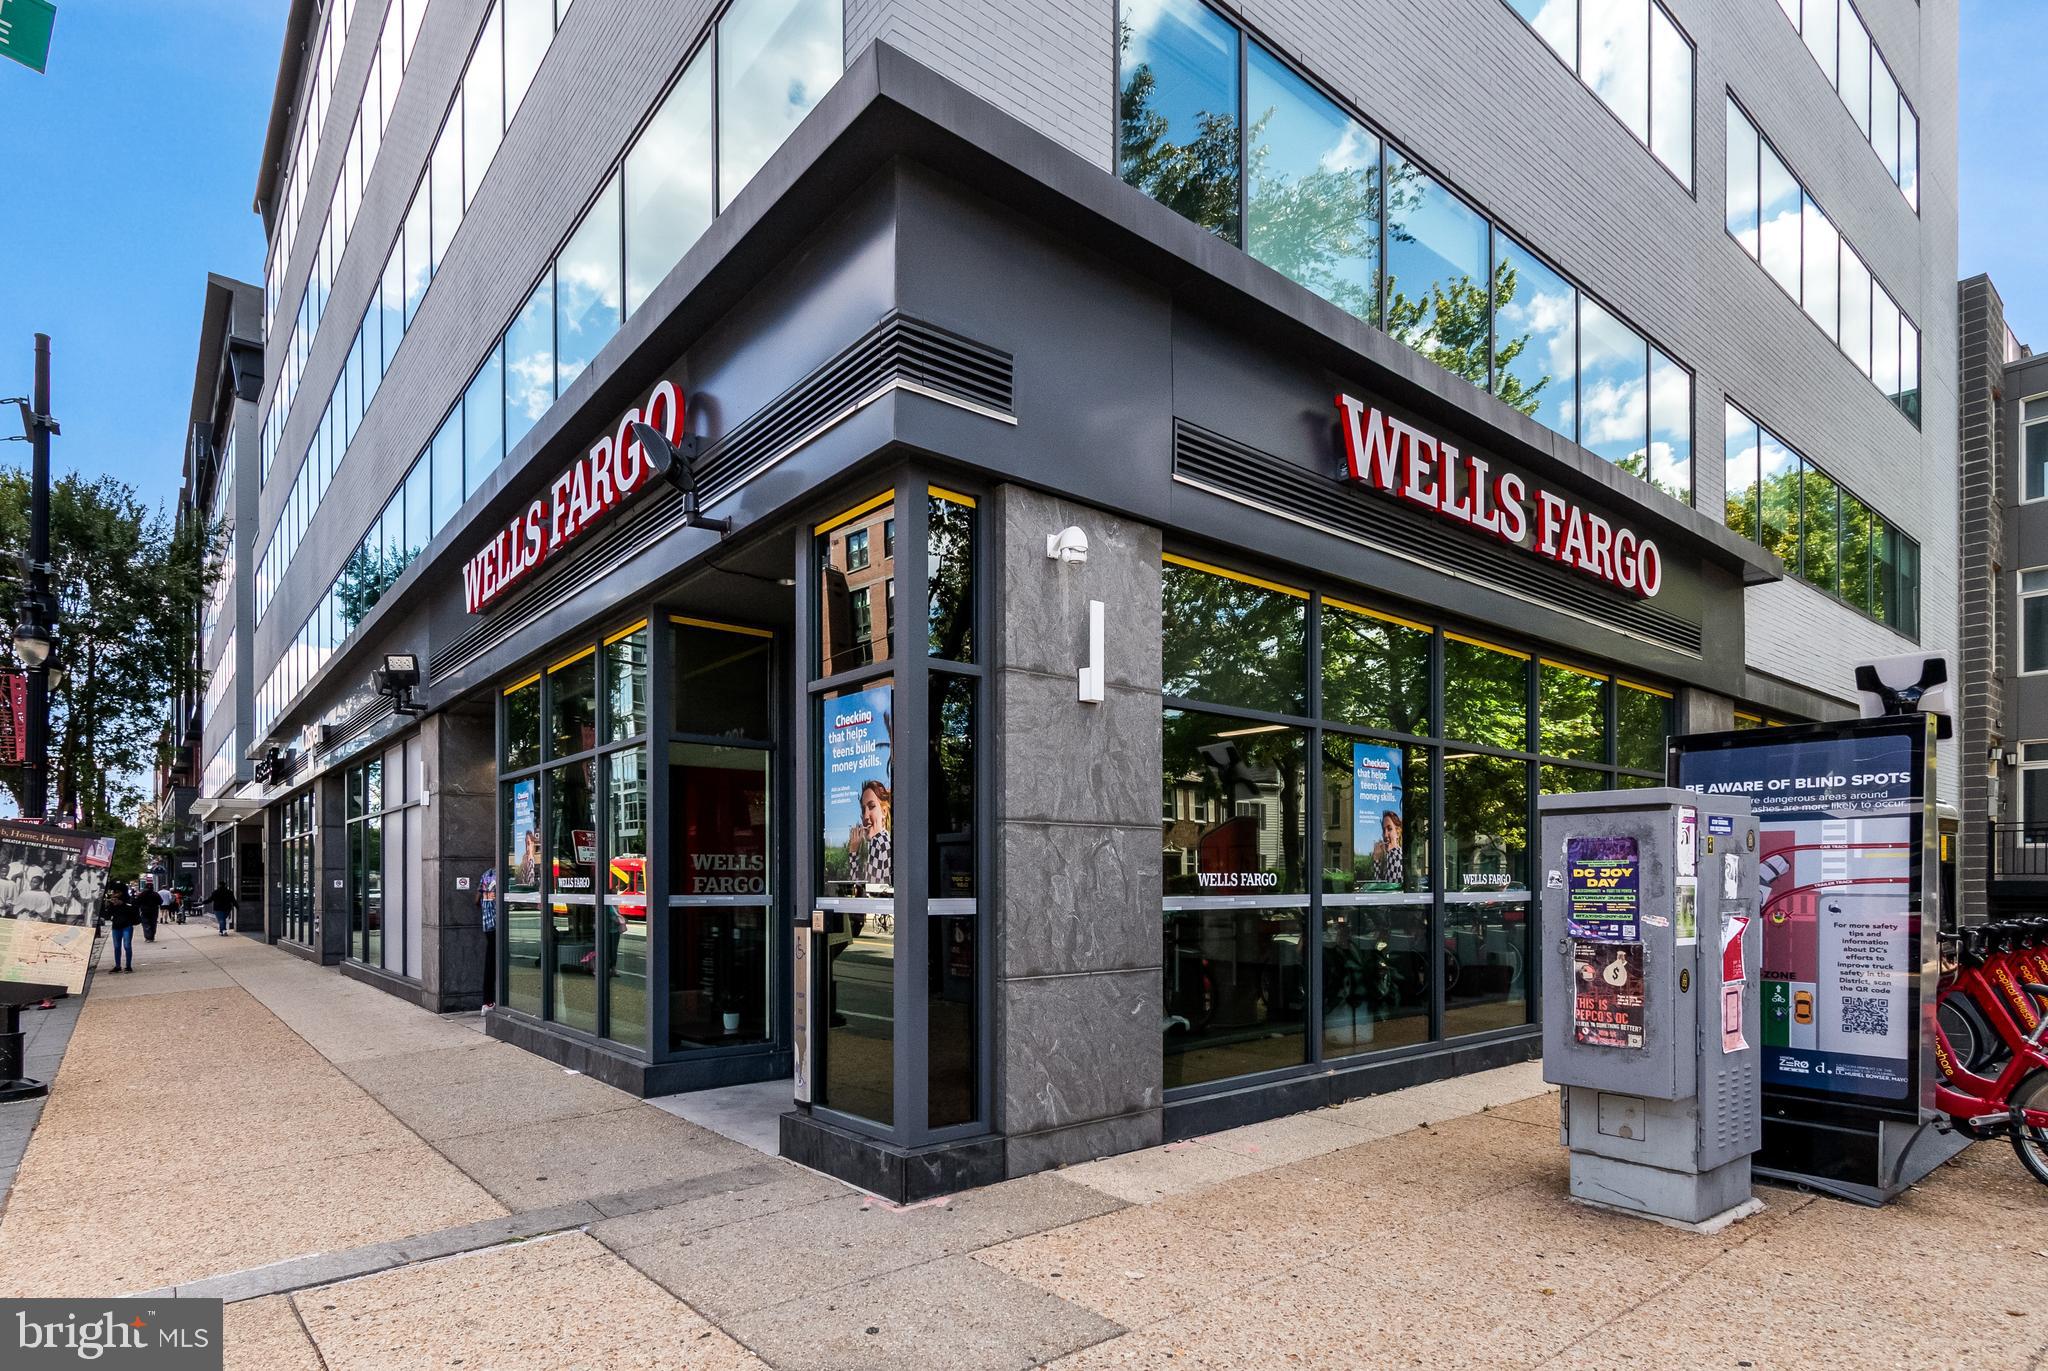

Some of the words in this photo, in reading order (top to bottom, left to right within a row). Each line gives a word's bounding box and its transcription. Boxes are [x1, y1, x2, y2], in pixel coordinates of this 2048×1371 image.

[462, 500, 548, 614] WELLS
[550, 380, 685, 549] FARGO
[1335, 393, 1526, 542] WELLS
[1534, 488, 1663, 600] FARGO
[836, 710, 872, 727] Checking
[829, 731, 845, 744] that
[847, 727, 868, 741] helps
[832, 747, 854, 758] teens
[856, 739, 876, 755] build
[832, 760, 858, 773] money
[859, 754, 882, 769] skills.
[1363, 758, 1390, 771] Checking
[1358, 768, 1370, 778] that
[1371, 770, 1387, 780] helps
[1361, 781, 1378, 790] teens
[1378, 782, 1393, 792] build
[1686, 784, 1704, 794] BE
[1708, 781, 1764, 794] AWARE
[1768, 779, 1790, 790] OF
[1795, 776, 1846, 789] BLIND
[1852, 772, 1911, 786] SPOTS
[1360, 793, 1380, 803] money
[1381, 792, 1396, 802] skills.
[1763, 795, 1816, 804] dangerous
[1819, 793, 1847, 801] areas
[1850, 791, 1888, 800] around
[1752, 805, 1779, 813] ashes
[1831, 802, 1858, 810] likely
[11, 830, 39, 841] Home,
[40, 834, 65, 844] Heart
[691, 854, 764, 871] WELLS
[1573, 868, 1596, 877] DC
[1600, 868, 1634, 877] JOY
[558, 878, 574, 888] WELLS
[574, 877, 590, 888] FARGO
[692, 876, 764, 893] FARGO
[1198, 873, 1238, 887] WELLS
[1240, 873, 1278, 887] FARGO
[1463, 874, 1488, 885] WELLS
[1488, 874, 1511, 885] FARGO
[1587, 879, 1620, 887] DAY
[1872, 923, 1898, 931] safety
[1760, 971, 1797, 980] -ZONE
[1840, 970, 1864, 978] safety
[1576, 997, 1595, 1011] THIS
[1599, 999, 1608, 1011] IS
[1996, 968, 2019, 996] capital
[2014, 995, 2038, 1030] bikesha
[1576, 1009, 1613, 1023] PEPCO'S
[1616, 1012, 1629, 1024] DC
[1620, 1024, 1642, 1032] BETTER?
